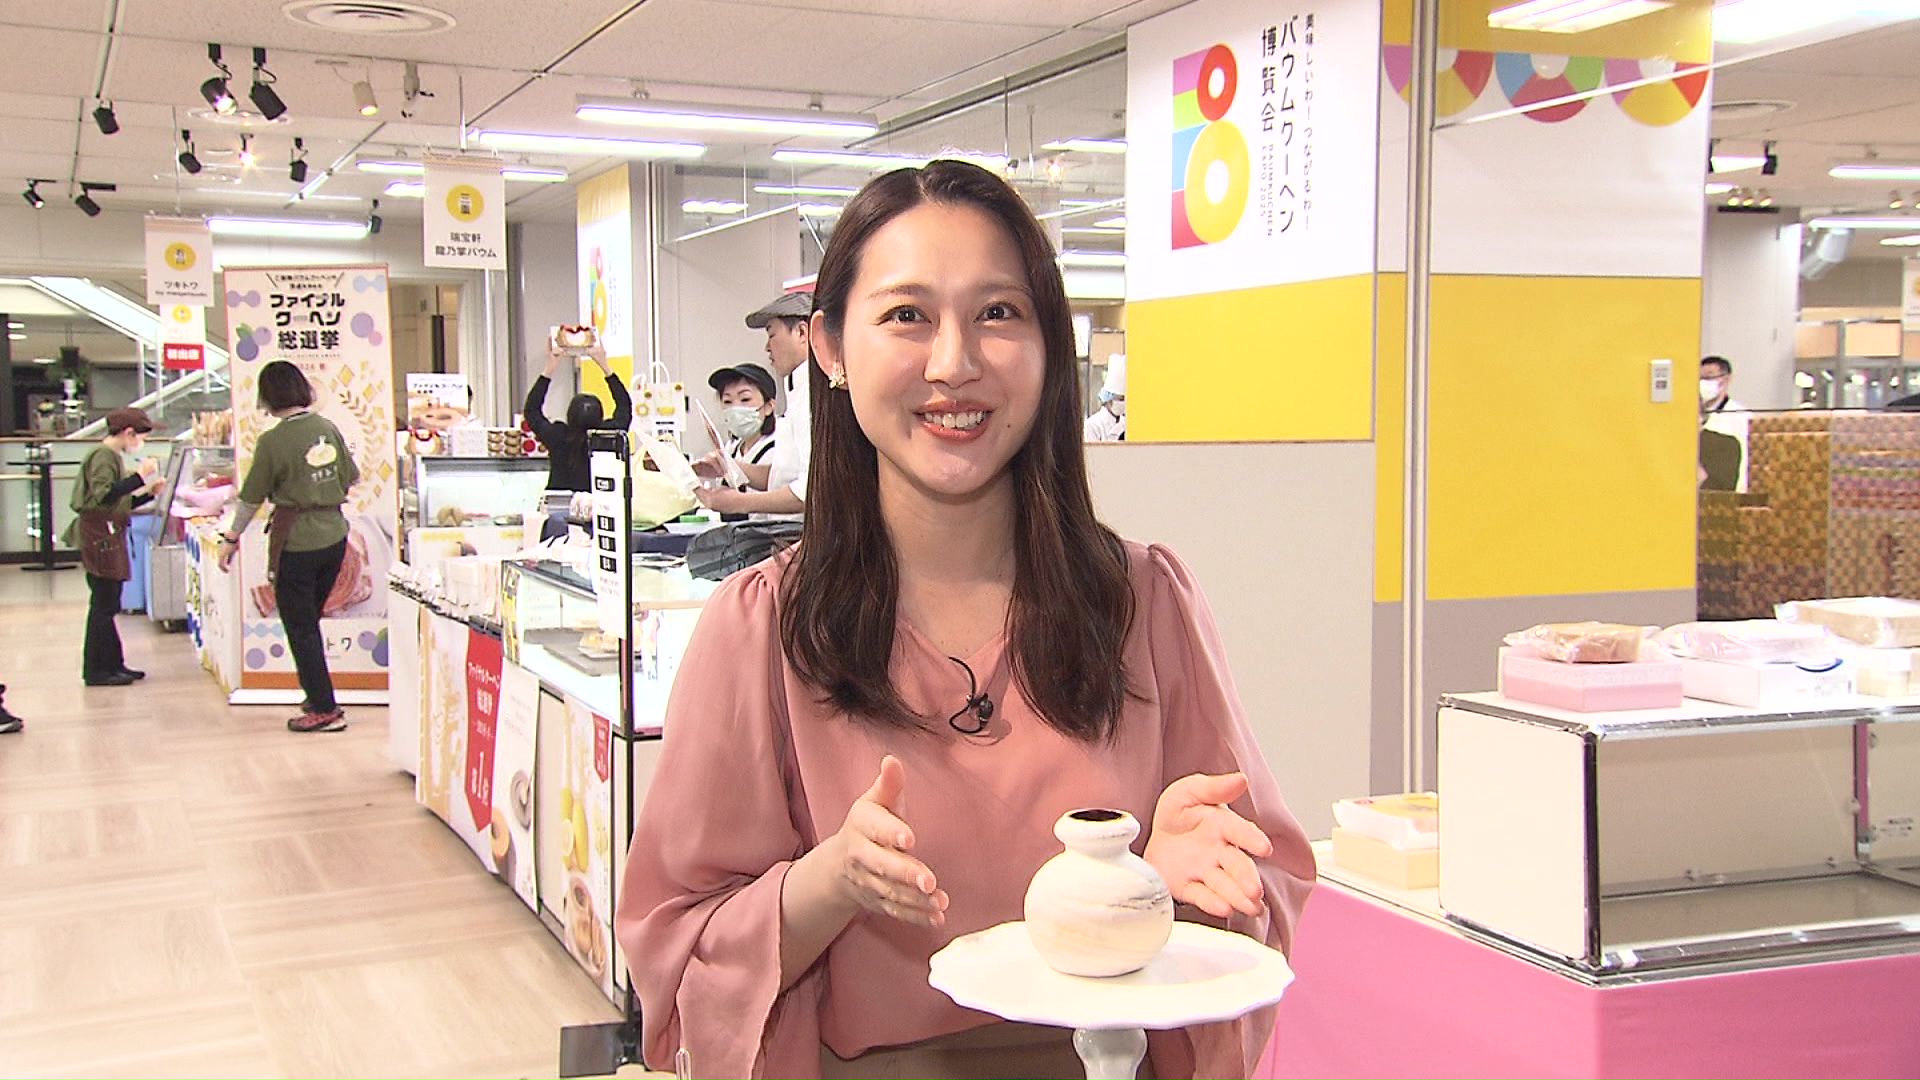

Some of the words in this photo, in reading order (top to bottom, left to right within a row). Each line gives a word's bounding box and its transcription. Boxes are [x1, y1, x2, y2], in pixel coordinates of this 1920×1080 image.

[1261, 26, 1278, 132] 博覧会
[1280, 14, 1299, 233] バウムクーヘン
[270, 293, 345, 308] ファイナル
[275, 311, 341, 326] クーヘン
[277, 330, 340, 350] 総選挙
